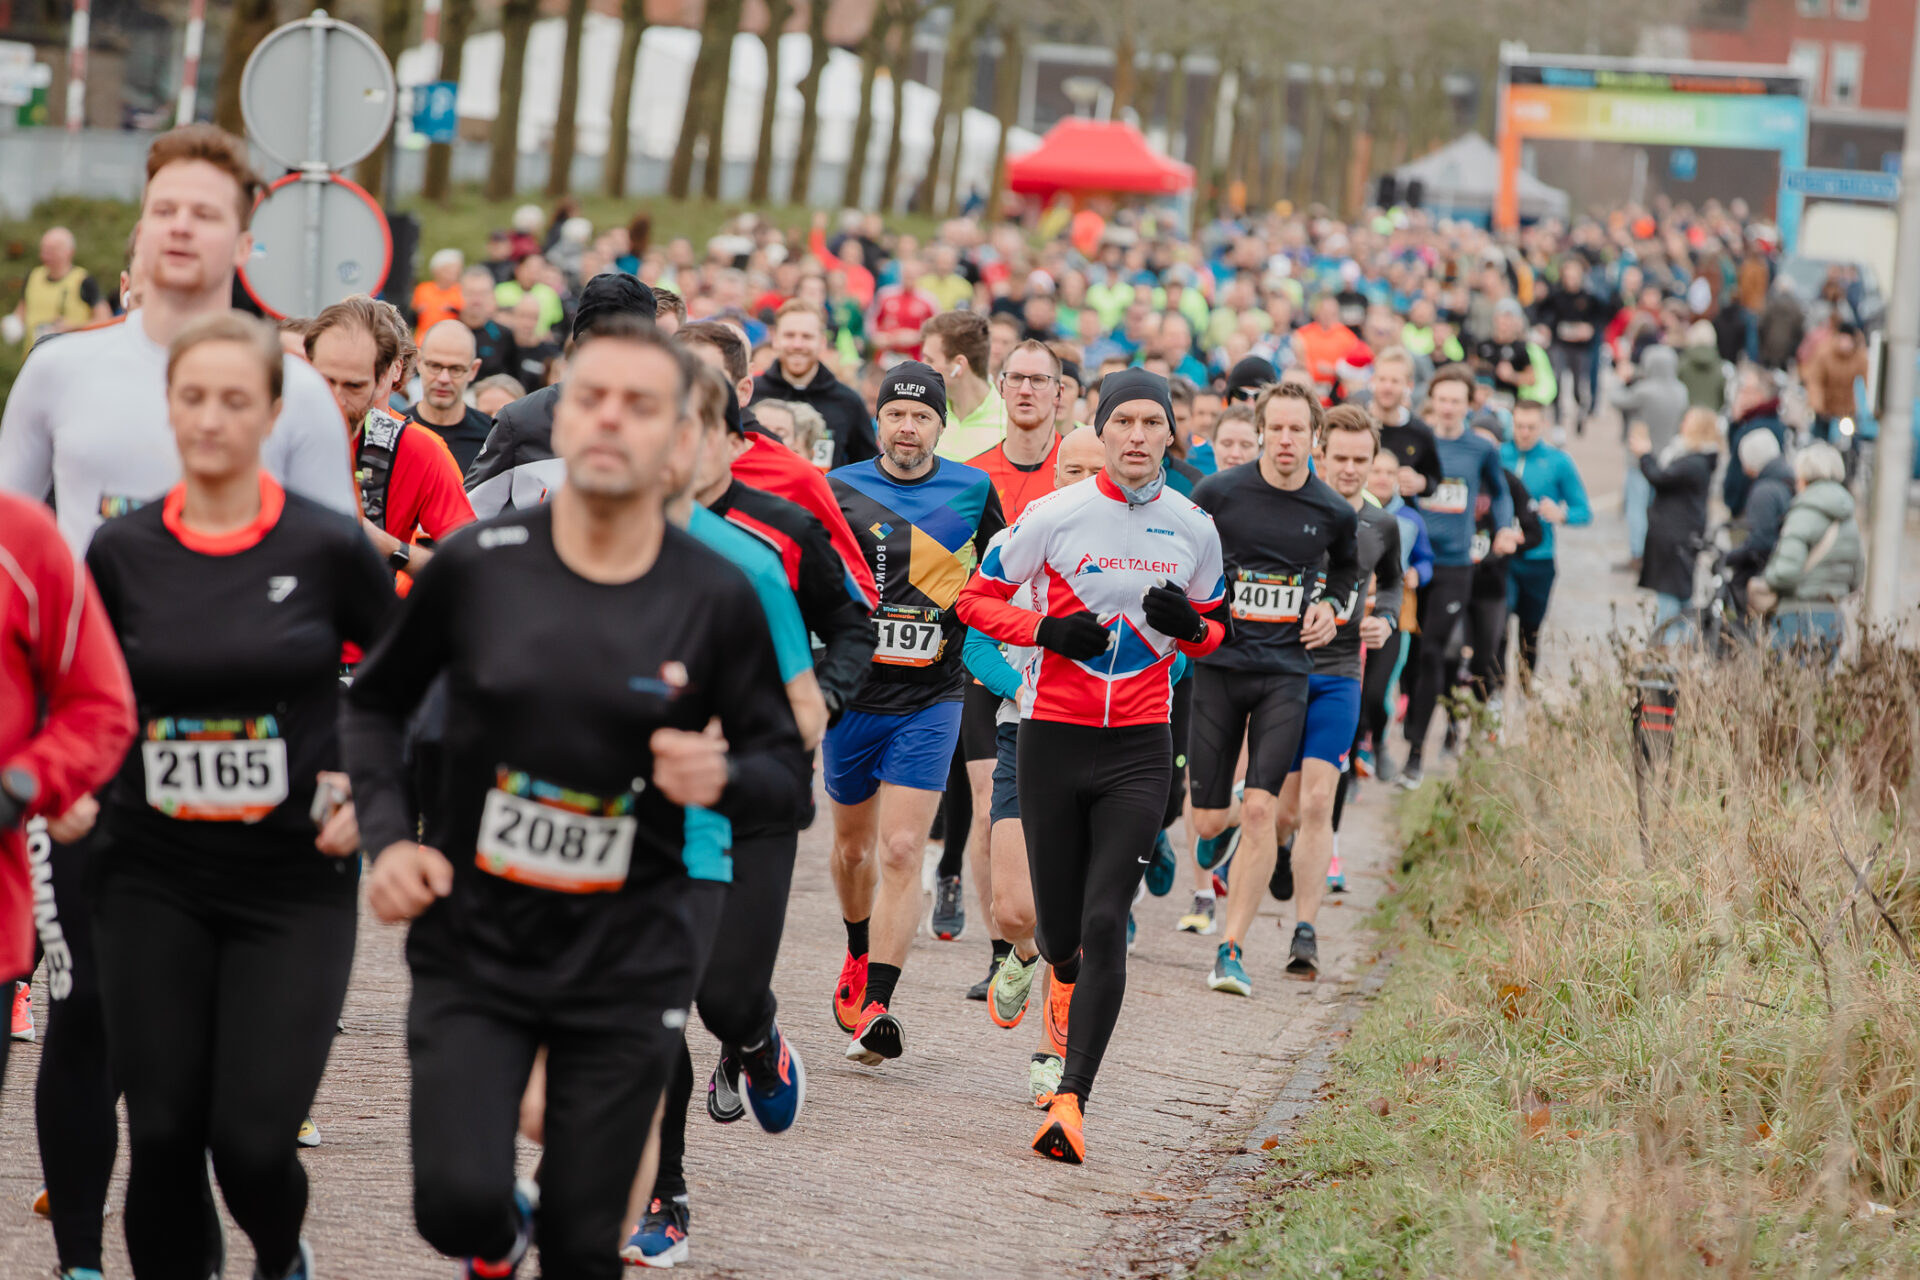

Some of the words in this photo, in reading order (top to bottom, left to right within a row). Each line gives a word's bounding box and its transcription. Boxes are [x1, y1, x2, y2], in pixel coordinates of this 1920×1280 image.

[1098, 557, 1179, 575] DELTALENT
[1239, 586, 1296, 609] 4011
[157, 749, 270, 791] 2165
[497, 805, 618, 864] 2087
